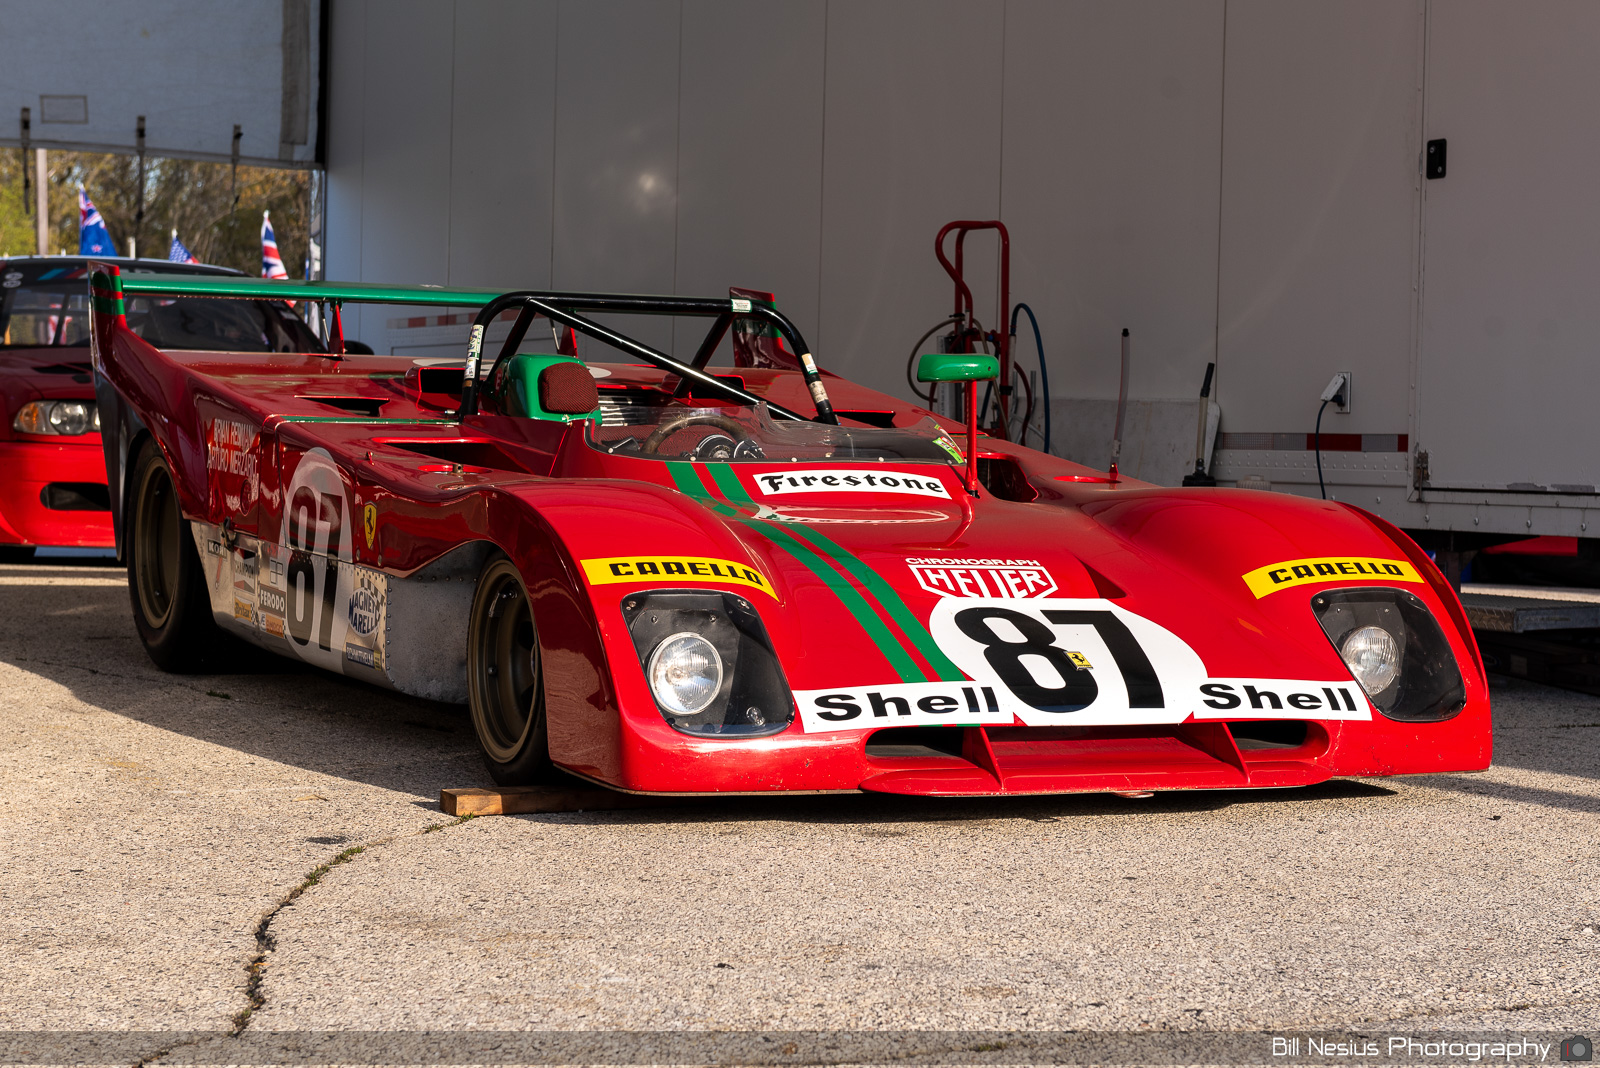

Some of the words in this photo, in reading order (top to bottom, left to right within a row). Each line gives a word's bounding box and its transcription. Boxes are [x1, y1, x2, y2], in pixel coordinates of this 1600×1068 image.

[207, 446, 229, 472] ARTURO
[230, 450, 257, 478] MERZARIO
[766, 473, 945, 496] Firestone
[289, 486, 342, 652] 87
[608, 560, 765, 587] CARELLO
[905, 557, 1041, 566] CHRONOGRAPH
[1267, 562, 1404, 584] CARELLO
[923, 569, 1049, 598] HEUER
[260, 589, 285, 612] FERODO
[954, 606, 1165, 713] 87
[814, 683, 1000, 722] Shell
[1200, 682, 1358, 712] Shell
